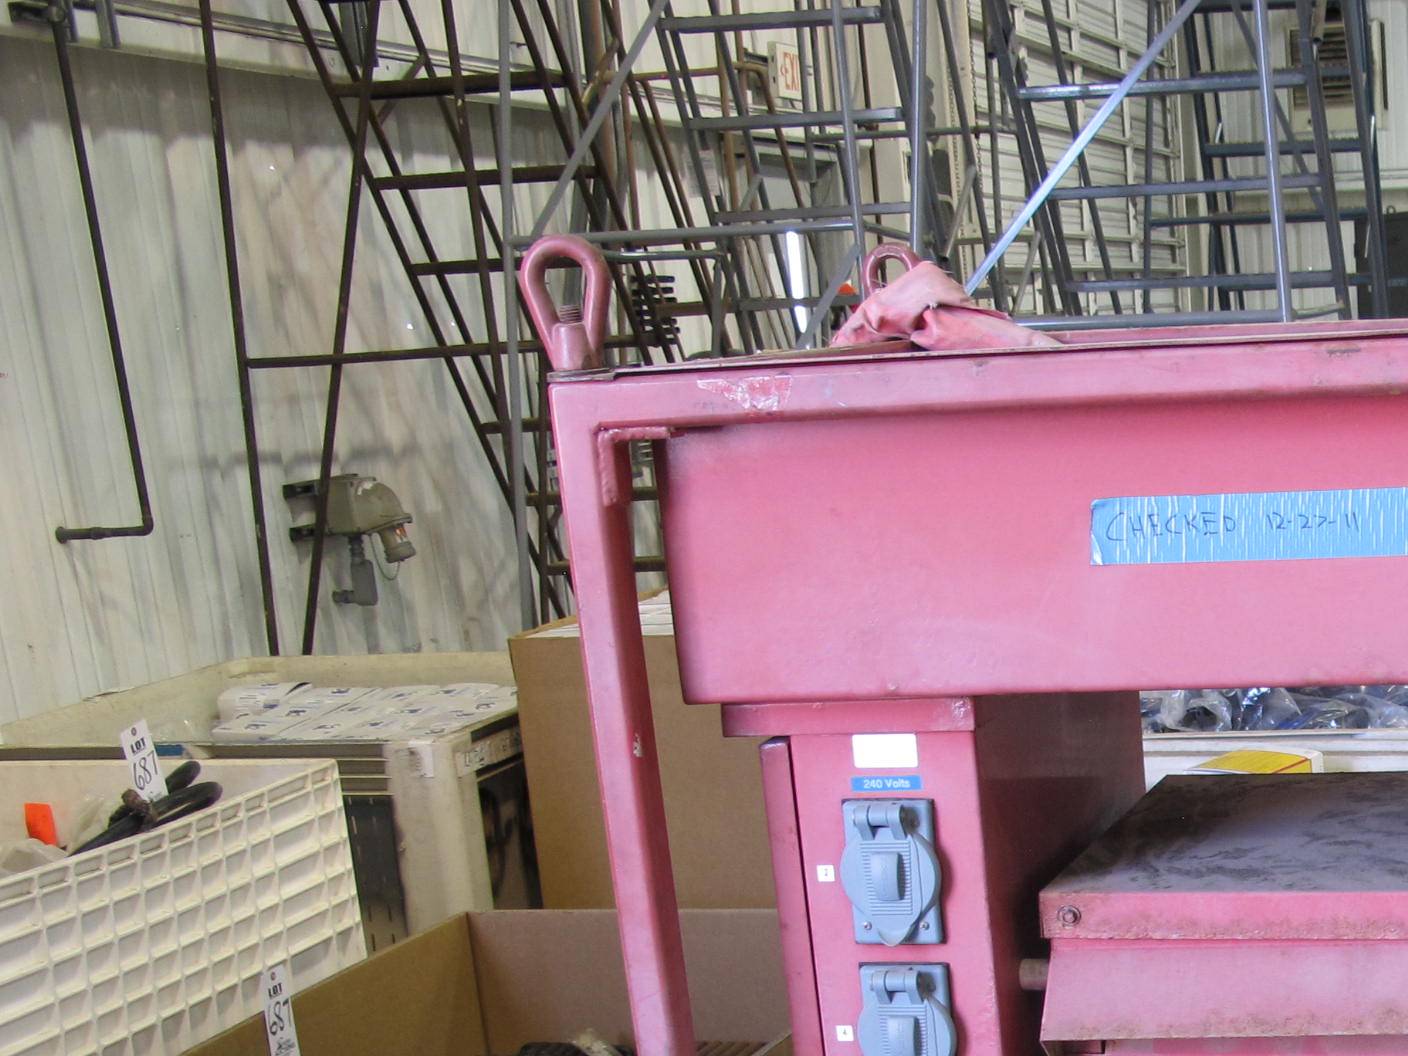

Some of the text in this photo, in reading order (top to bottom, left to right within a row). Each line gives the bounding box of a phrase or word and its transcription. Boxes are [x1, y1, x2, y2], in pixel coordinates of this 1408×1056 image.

[1106, 511, 1236, 541] CHECKED
[130, 737, 147, 755] LOT
[132, 750, 159, 791] 687
[863, 777, 911, 789] 240 Volts
[267, 982, 283, 998] LOT
[268, 998, 292, 1037] 687
